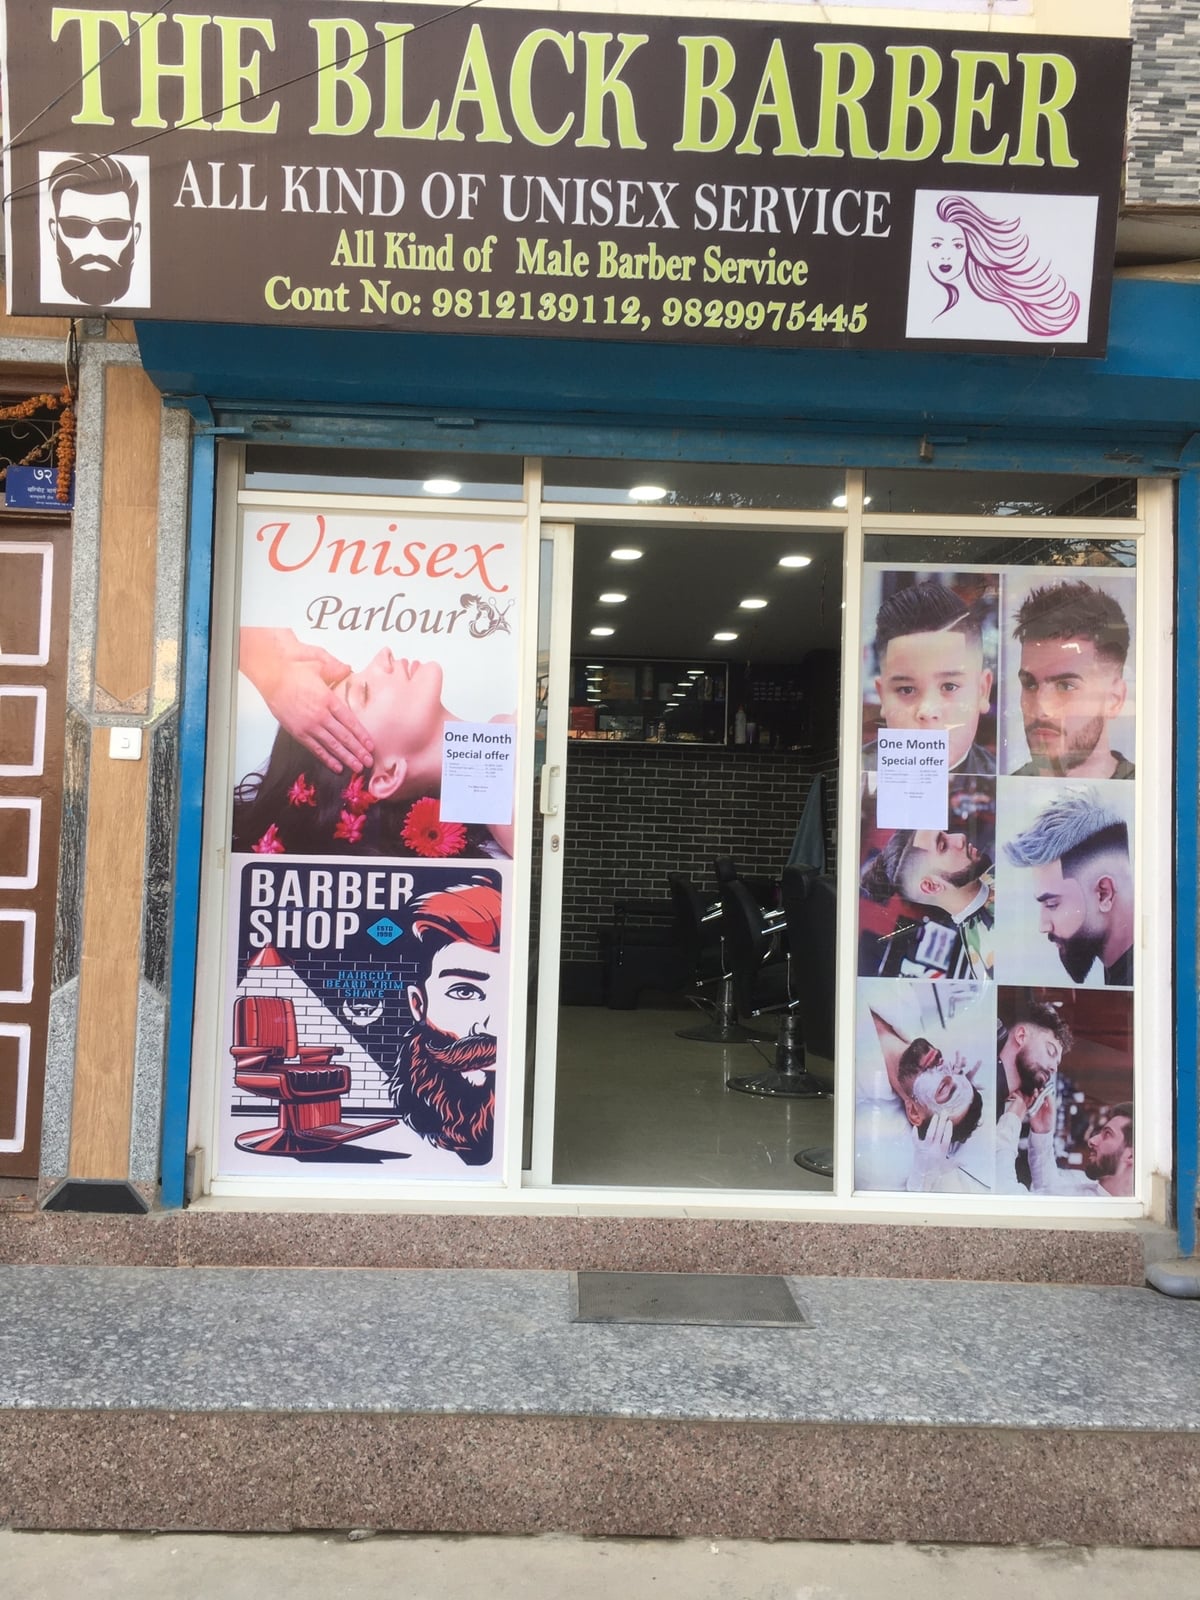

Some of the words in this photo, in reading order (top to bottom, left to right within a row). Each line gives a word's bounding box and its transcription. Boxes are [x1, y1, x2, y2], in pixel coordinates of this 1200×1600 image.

[51, 7, 280, 134] THE
[308, 17, 650, 151] BLACK
[673, 35, 1080, 168] BARBER
[173, 160, 268, 211] ALL
[281, 165, 405, 217] KIND
[421, 171, 487, 219] OF
[500, 174, 680, 229] UNISEX
[694, 183, 892, 238] SERVICE
[330, 229, 376, 268] All
[384, 231, 455, 272] Kind
[463, 235, 498, 272] of
[515, 237, 589, 277] Male
[597, 240, 696, 282] Barber
[703, 245, 809, 287] Service
[264, 275, 350, 313] Cont
[360, 279, 421, 317] No:
[431, 288, 652, 331] 9812139112,
[662, 297, 868, 333] 9829975445
[256, 515, 509, 593] Unisex
[306, 593, 467, 634] Parlour
[444, 731, 469, 743] One
[472, 732, 512, 745] Month
[446, 748, 482, 760] Special
[484, 750, 510, 761] offer
[879, 738, 903, 750] One
[906, 739, 946, 751] Month
[881, 755, 917, 767] Special
[919, 756, 945, 766] offer
[250, 868, 414, 911] BARBER
[249, 909, 360, 950] SHOP
[326, 979, 367, 989] BEARD
[372, 980, 404, 990] TRIM
[338, 970, 393, 981] HAIRCUT
[344, 988, 385, 998] SHAVE
